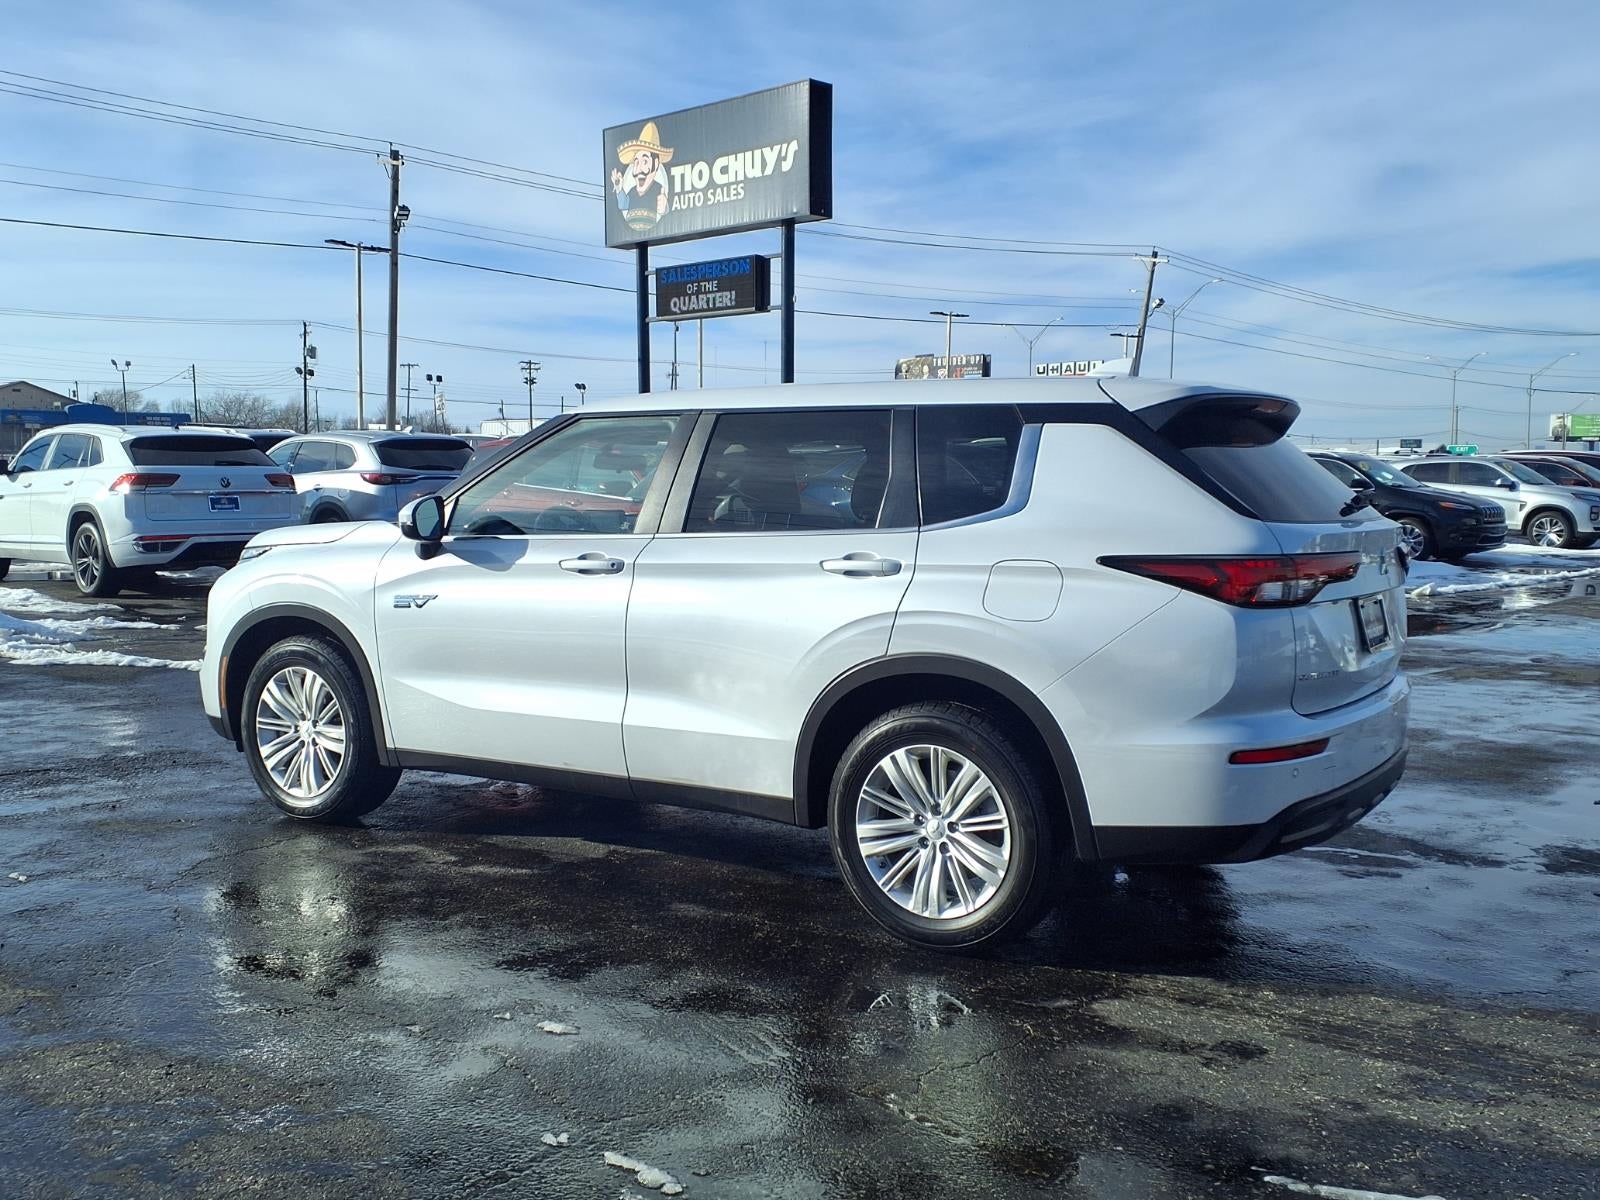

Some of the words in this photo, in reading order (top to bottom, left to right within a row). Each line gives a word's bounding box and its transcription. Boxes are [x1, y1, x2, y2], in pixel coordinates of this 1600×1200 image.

[671, 161, 710, 193] TIO
[712, 139, 799, 185] CHUY'S
[671, 191, 704, 211] AUTO
[707, 183, 745, 206] SALES
[662, 258, 750, 284] SALESPERSON
[686, 283, 698, 294] OF
[700, 280, 718, 292] THE
[670, 290, 736, 313] QUARTER!
[933, 355, 967, 367] THUDER
